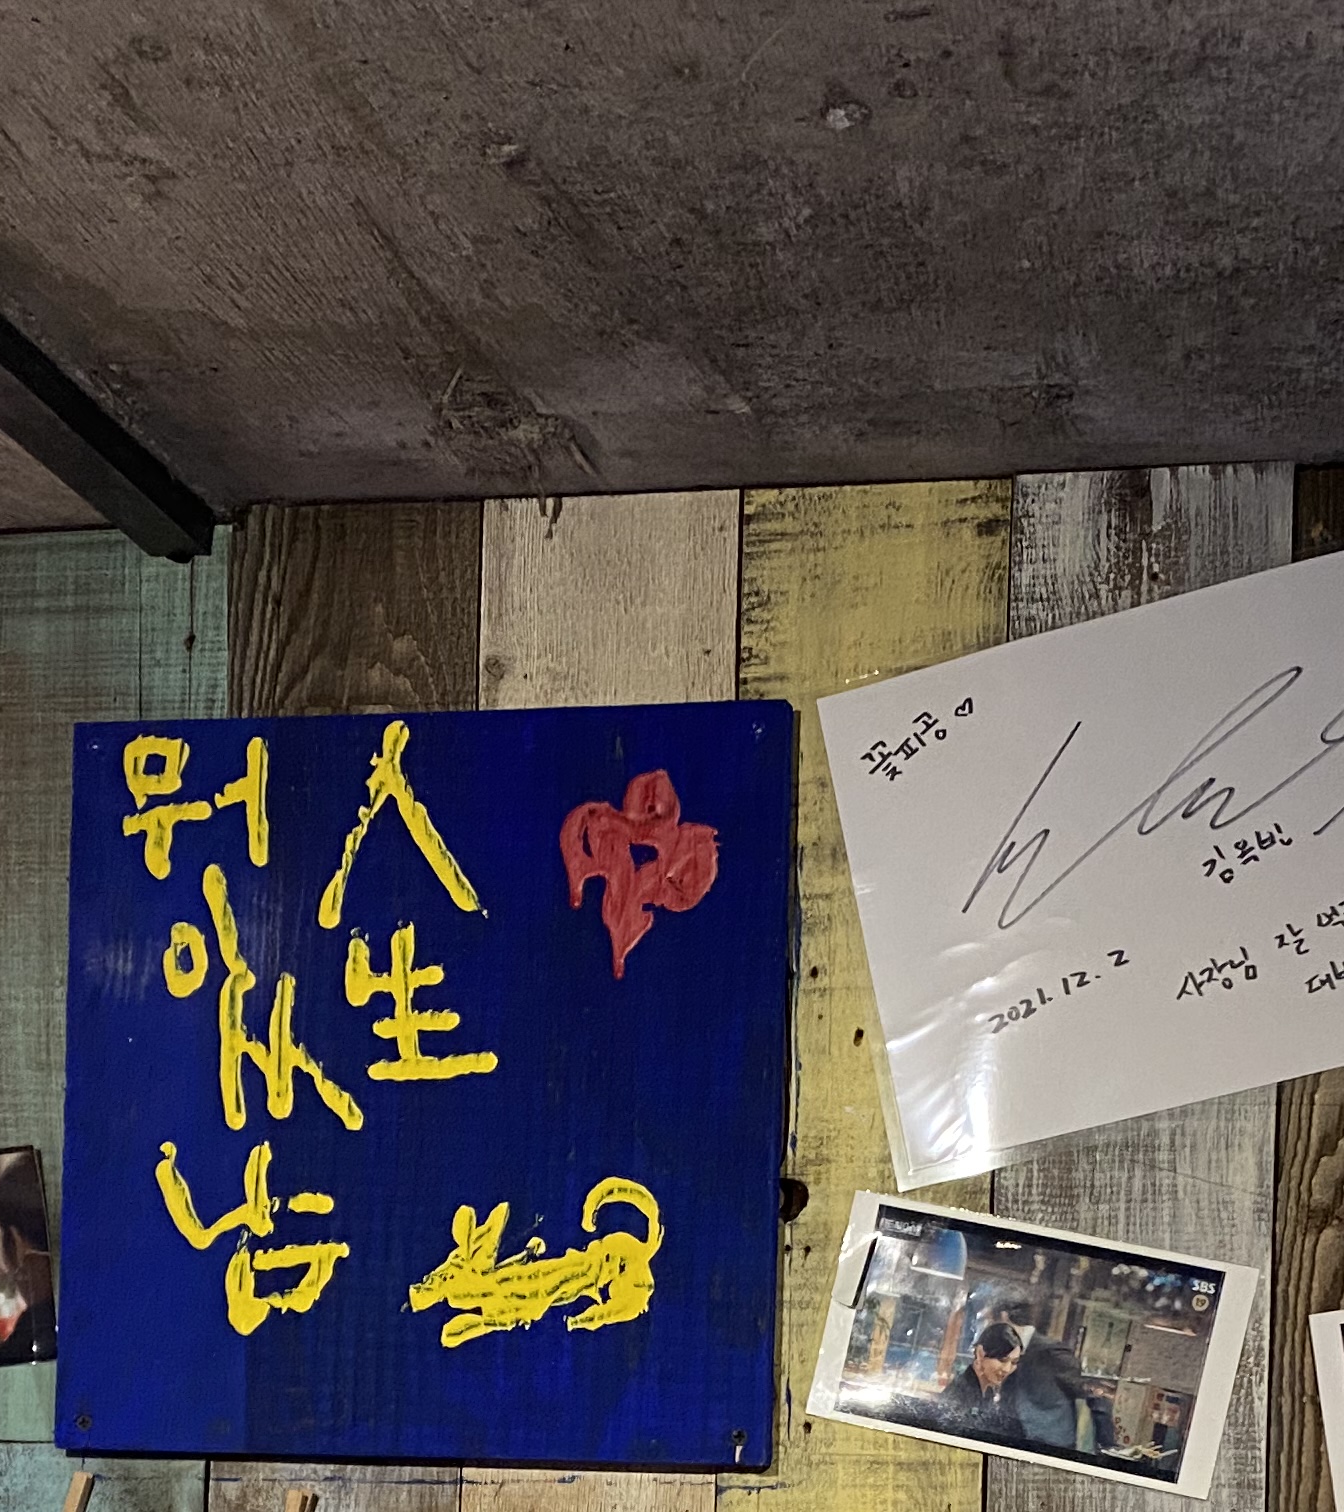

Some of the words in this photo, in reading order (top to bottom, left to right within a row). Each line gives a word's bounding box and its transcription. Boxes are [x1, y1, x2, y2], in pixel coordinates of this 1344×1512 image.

[1202, 823, 1293, 883] 김옥빈
[1176, 946, 1258, 1000] 사장님
[1274, 923, 1310, 956] 잘
[1191, 1280, 1217, 1295] SBS
